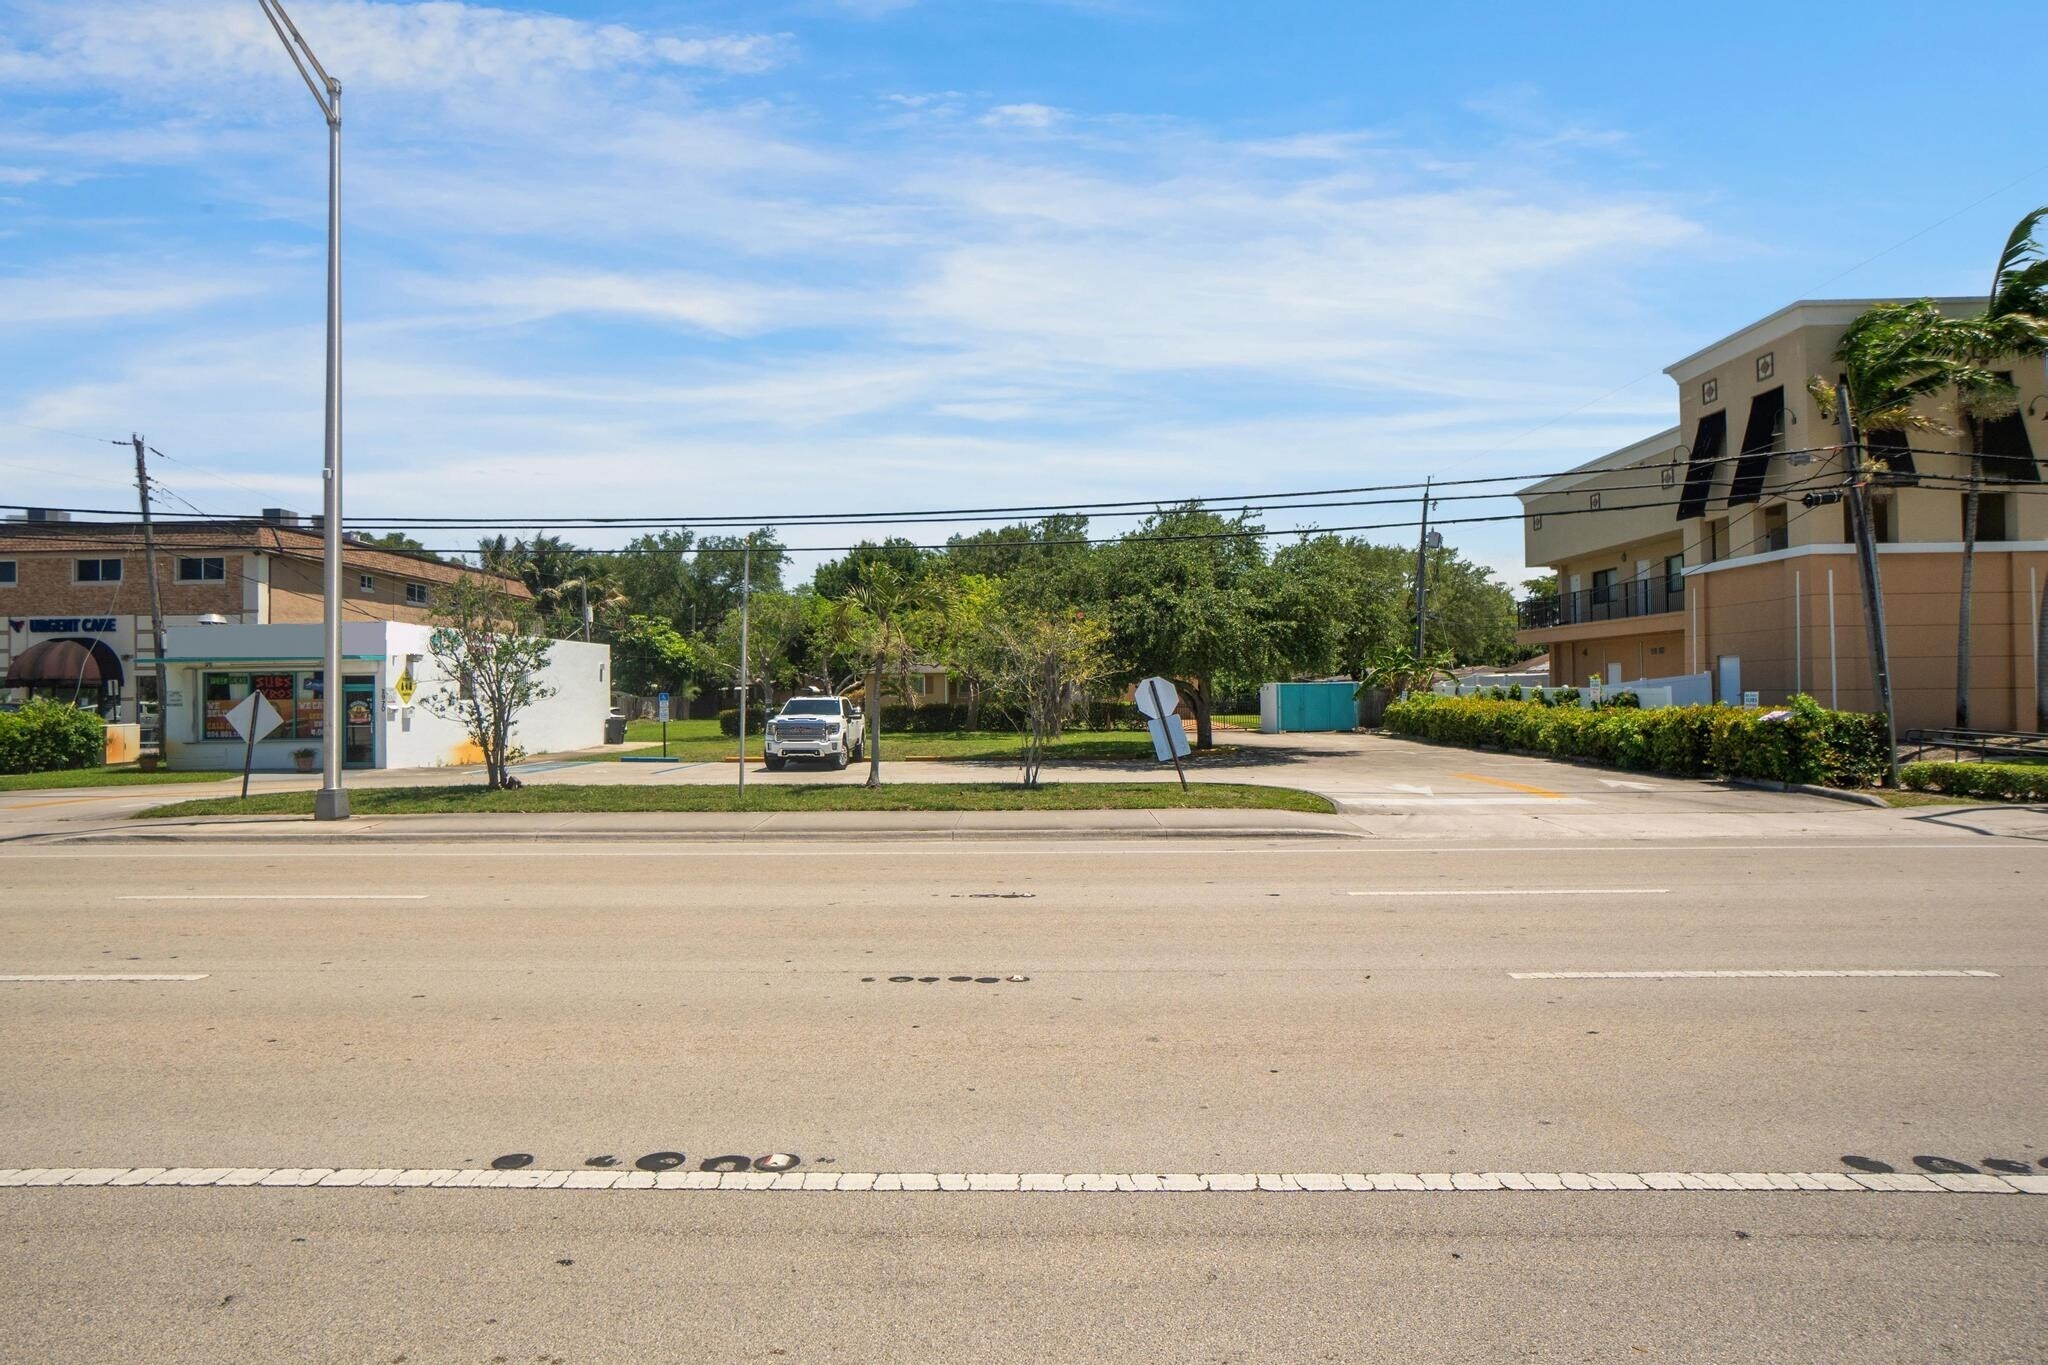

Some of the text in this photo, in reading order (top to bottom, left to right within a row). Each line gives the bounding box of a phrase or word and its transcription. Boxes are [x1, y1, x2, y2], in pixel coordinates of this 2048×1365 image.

[29, 618, 117, 632] URGENT CARE
[255, 676, 291, 688] SUBS
[263, 687, 292, 699] YROS
